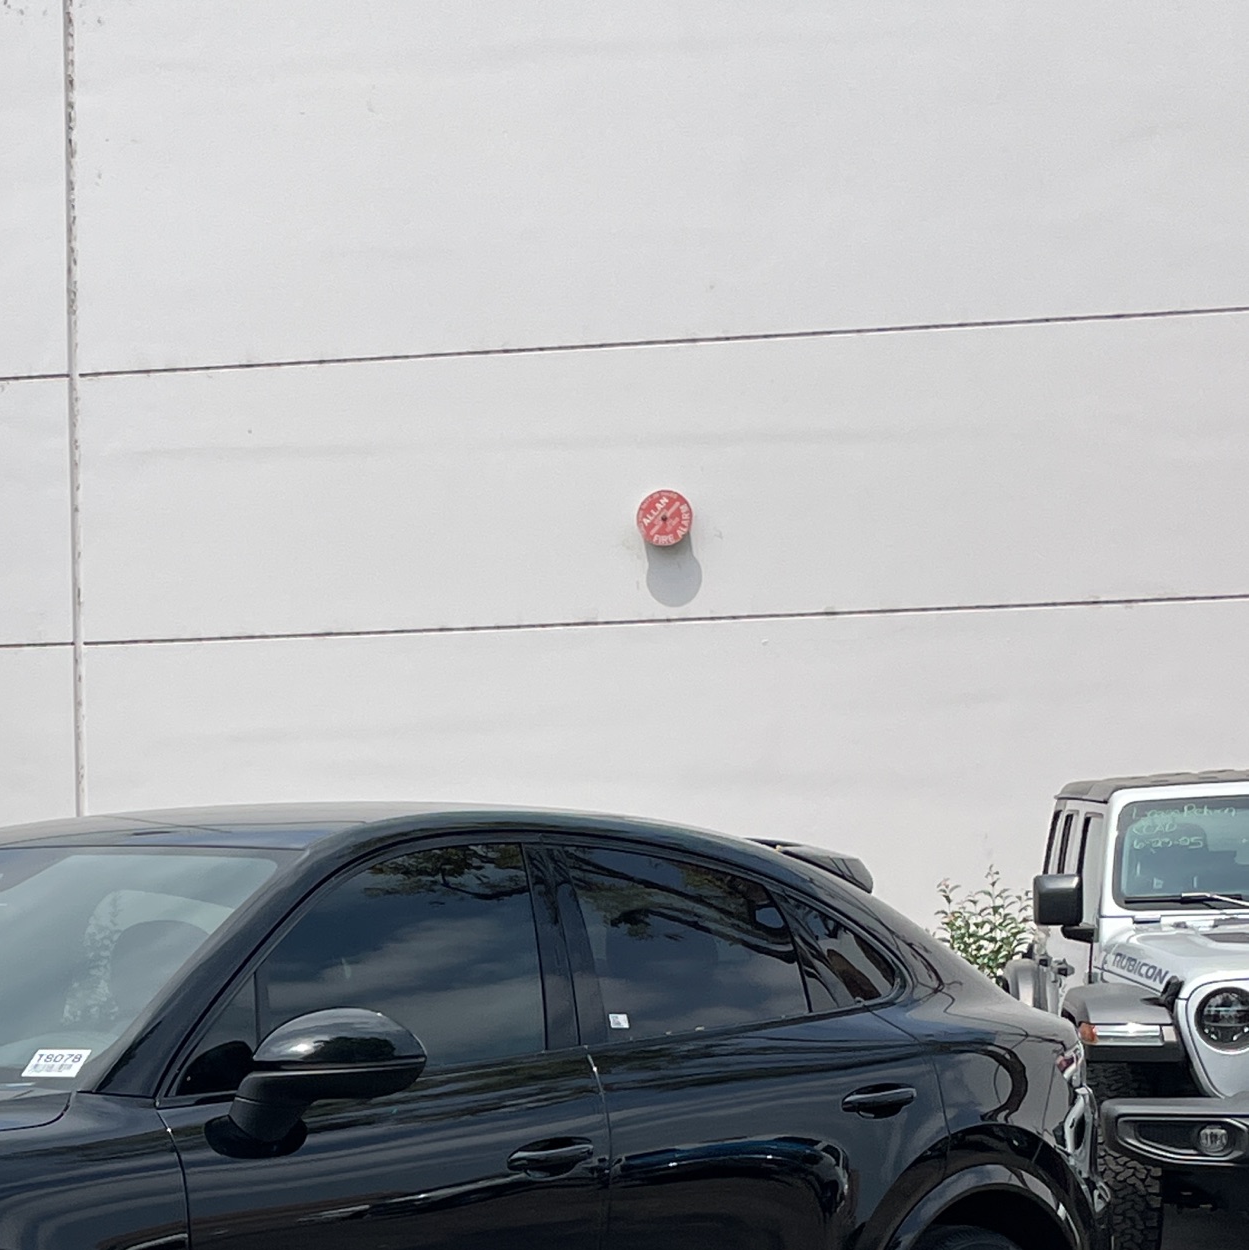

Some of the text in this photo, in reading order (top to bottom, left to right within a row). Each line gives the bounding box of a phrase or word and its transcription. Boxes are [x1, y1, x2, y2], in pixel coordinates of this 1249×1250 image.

[652, 503, 691, 545] FIRE ALARM
[1112, 952, 1169, 984] RUBICON
